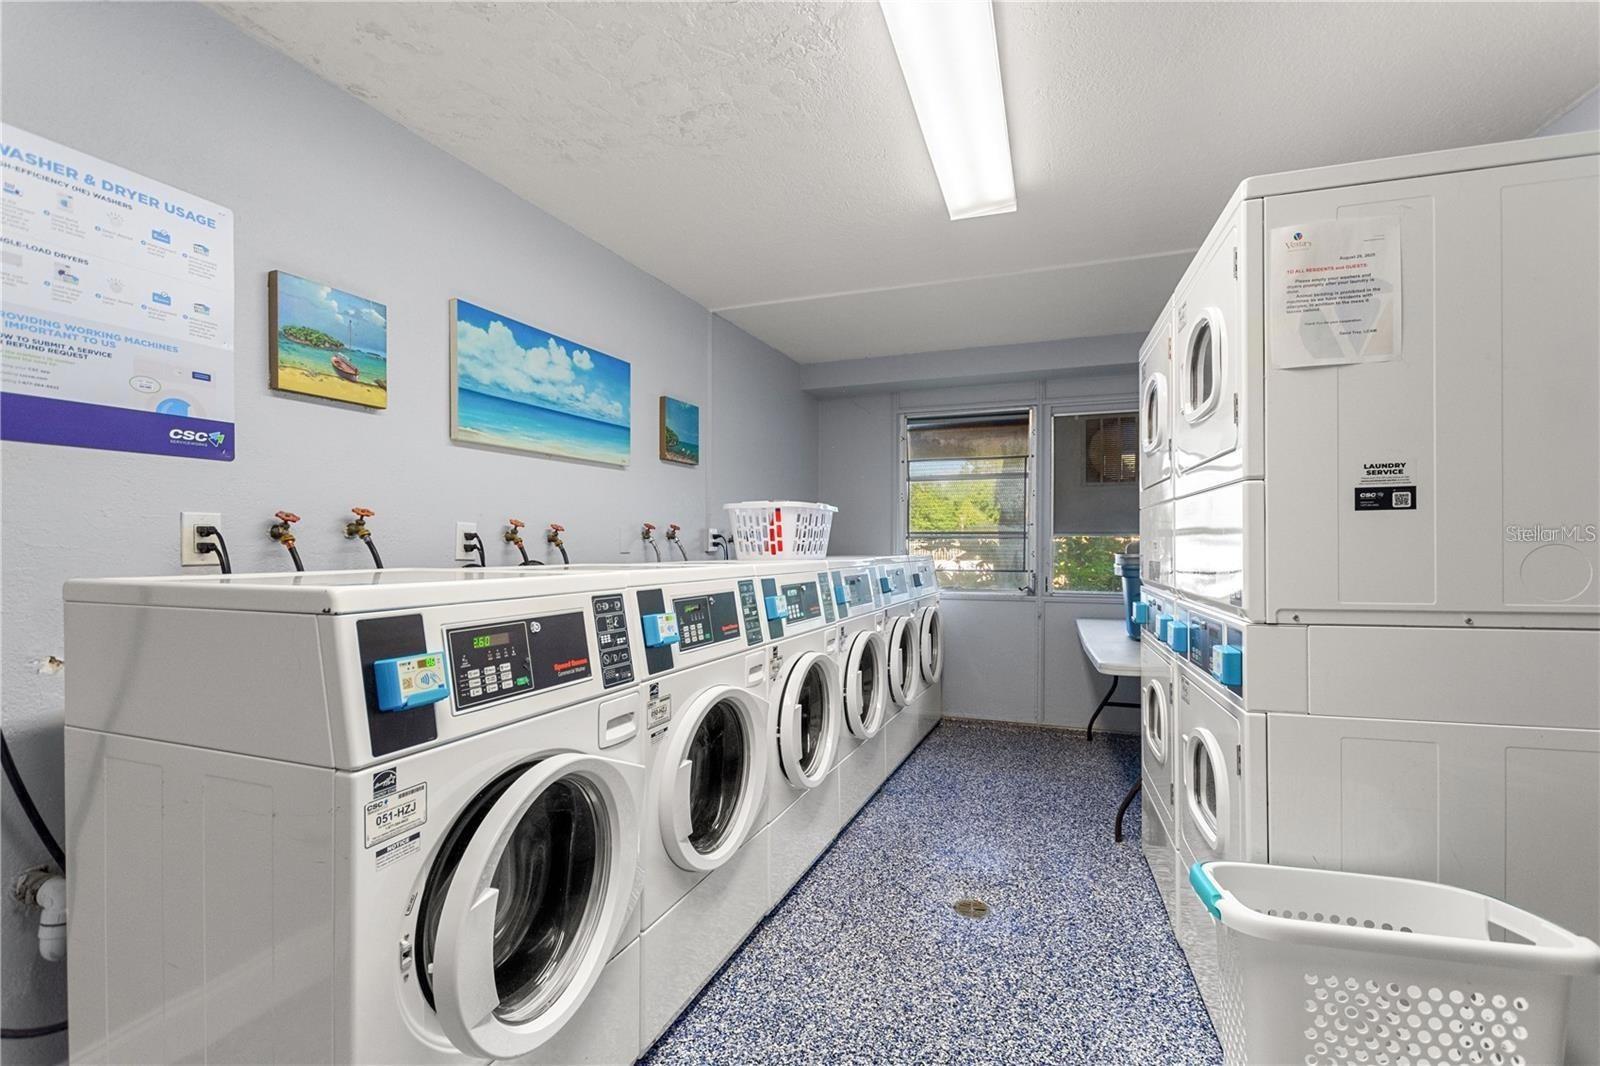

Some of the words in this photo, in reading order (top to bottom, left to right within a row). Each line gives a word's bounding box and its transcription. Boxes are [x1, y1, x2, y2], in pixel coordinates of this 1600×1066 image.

[71, 184, 90, 197] (HE)
[92, 192, 133, 210] WASHERS
[84, 173, 96, 187] &
[102, 179, 160, 209] DRYER
[164, 201, 217, 230] USAGE
[54, 250, 89, 266] DRYERS
[4, 320, 78, 341] IMPORTANT
[82, 336, 98, 345] TO
[102, 340, 117, 348] US
[64, 323, 122, 342] WORKING
[124, 336, 179, 353] MACHINES
[6, 340, 45, 352] REFUND
[47, 347, 89, 360] REQUEST
[16, 335, 30, 343] TO
[32, 338, 68, 350] SUBMIT
[77, 346, 112, 358] SERVICE
[169, 428, 208, 442] CSC
[1364, 462, 1406, 470] LAUNDRY
[1366, 468, 1404, 476] SERVICE
[367, 800, 384, 812] CSC
[376, 802, 416, 826] 051-HZJ
[386, 838, 410, 852] NOTICE
